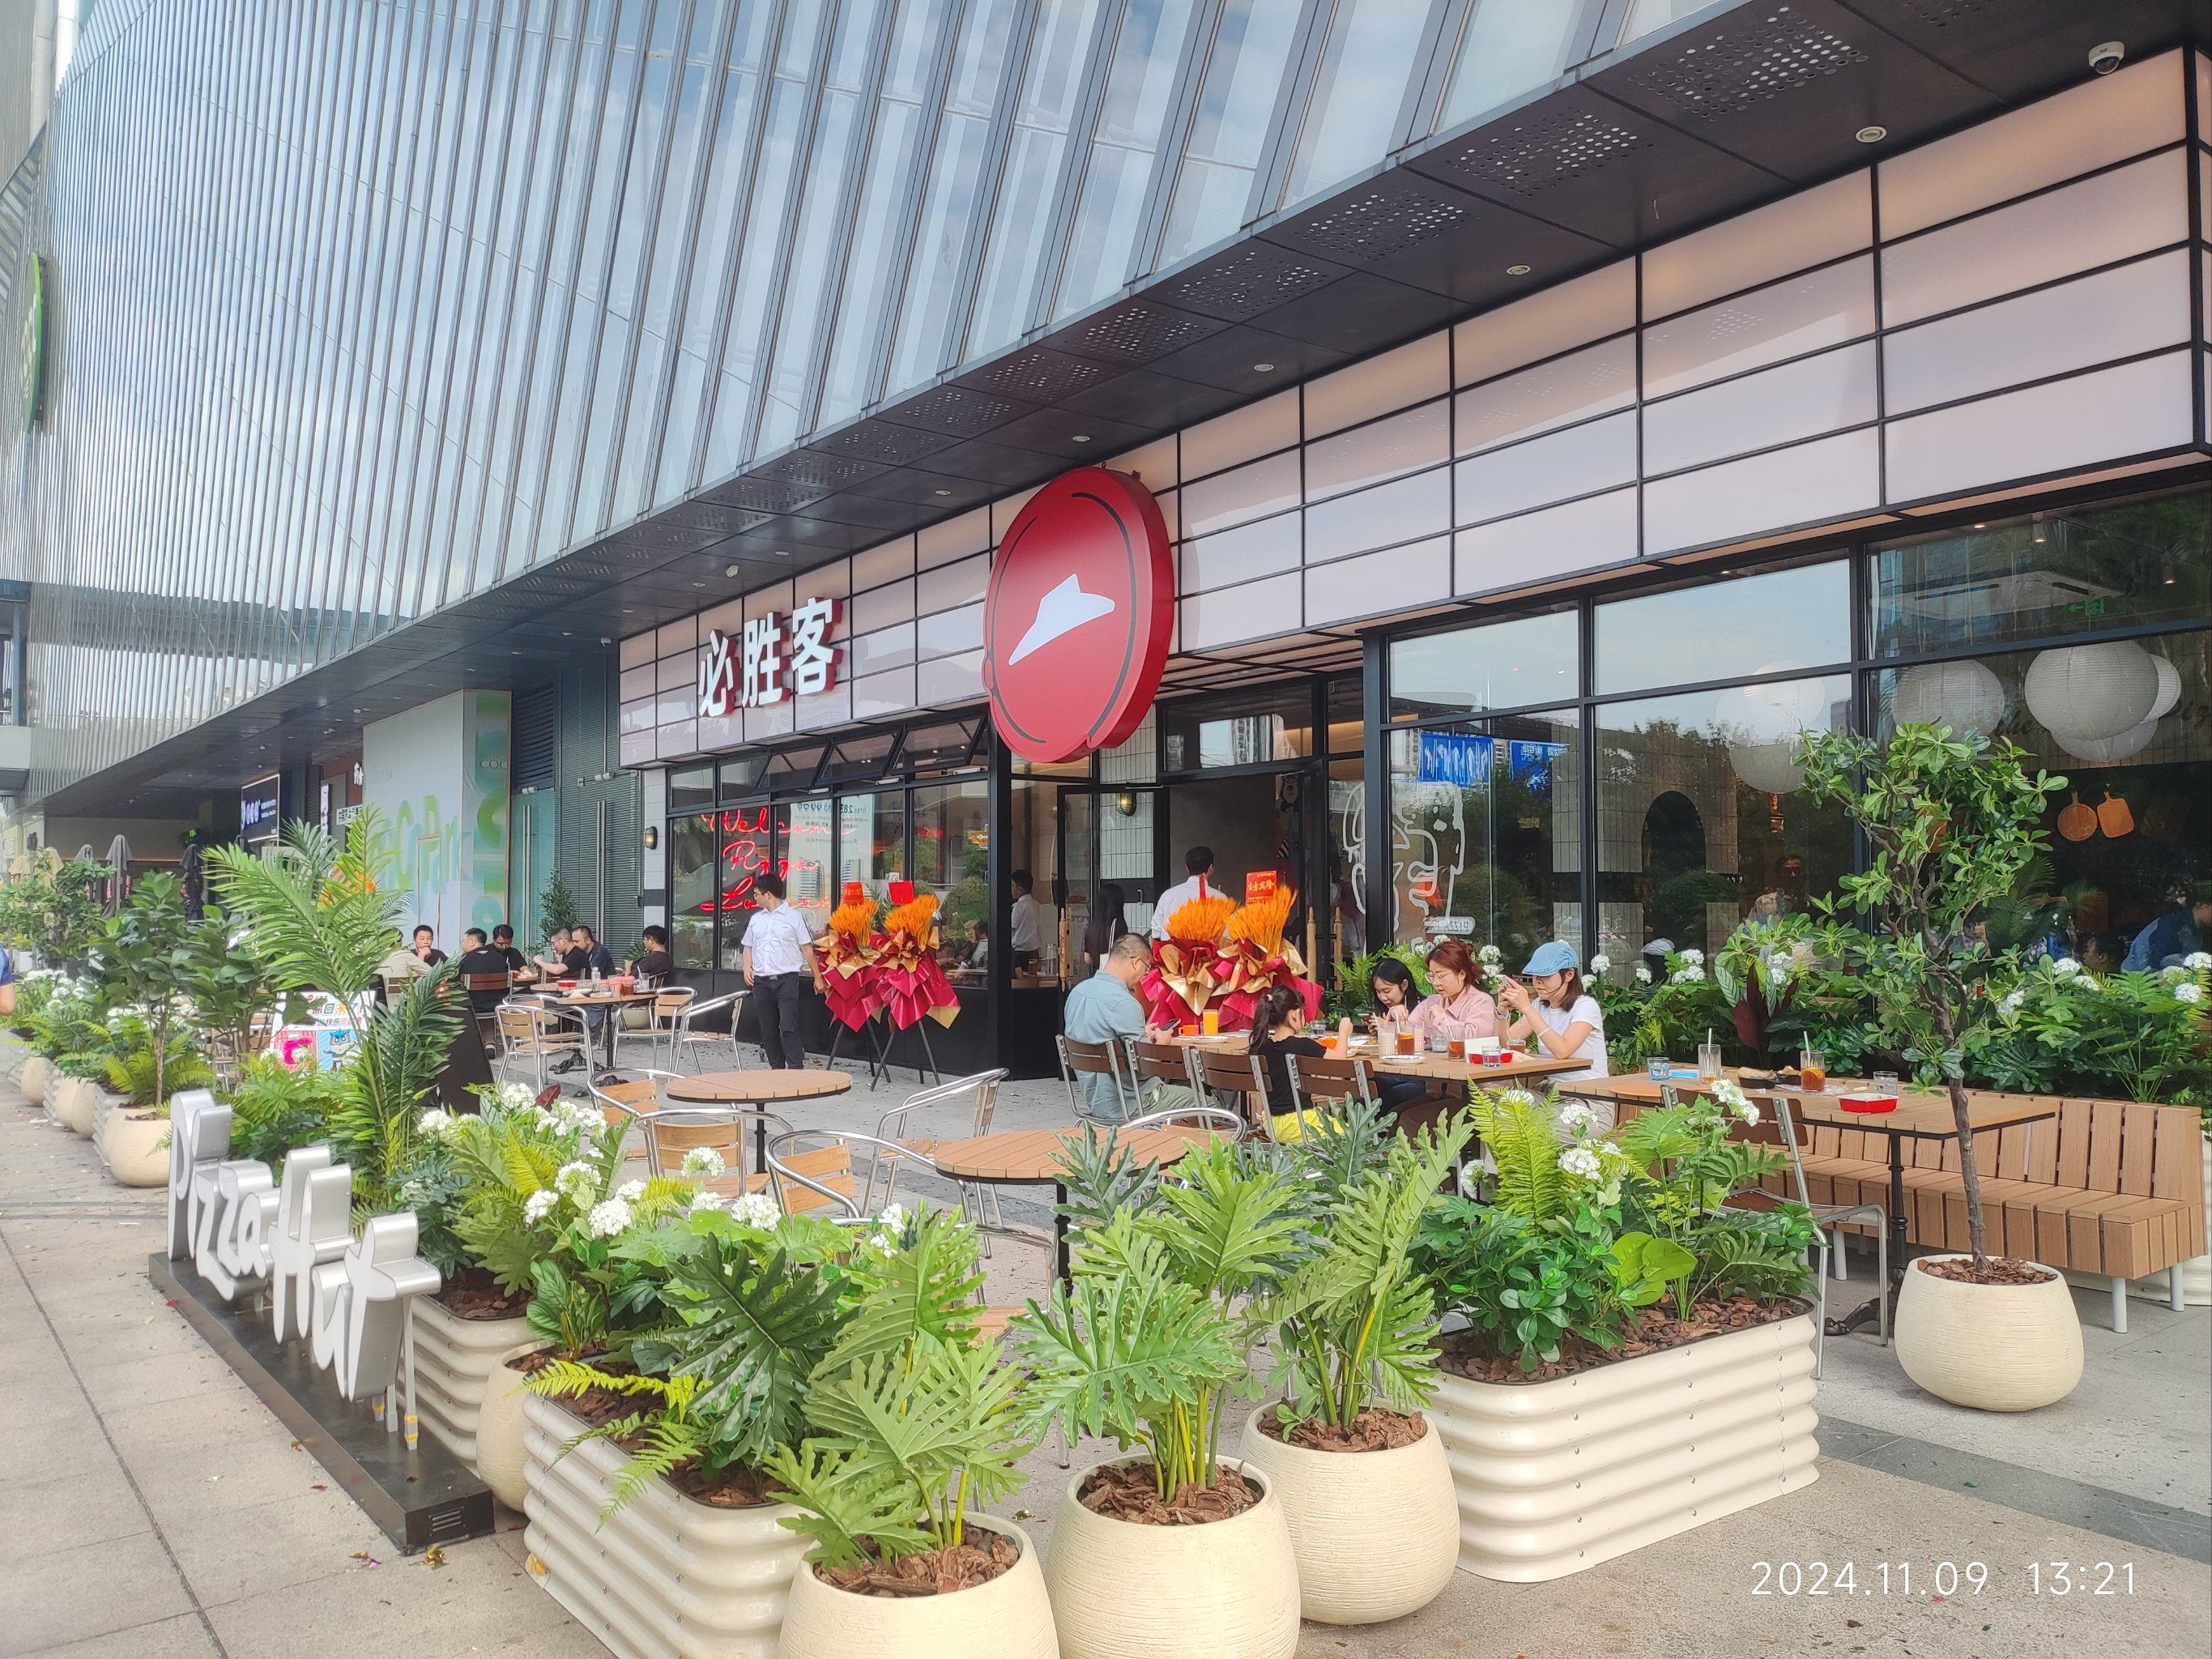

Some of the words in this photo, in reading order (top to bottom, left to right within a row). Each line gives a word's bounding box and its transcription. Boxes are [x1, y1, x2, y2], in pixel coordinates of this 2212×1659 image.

[697, 597, 838, 718] 必胜客
[168, 1090, 271, 1301] Pizza
[267, 1145, 425, 1402] Hut
